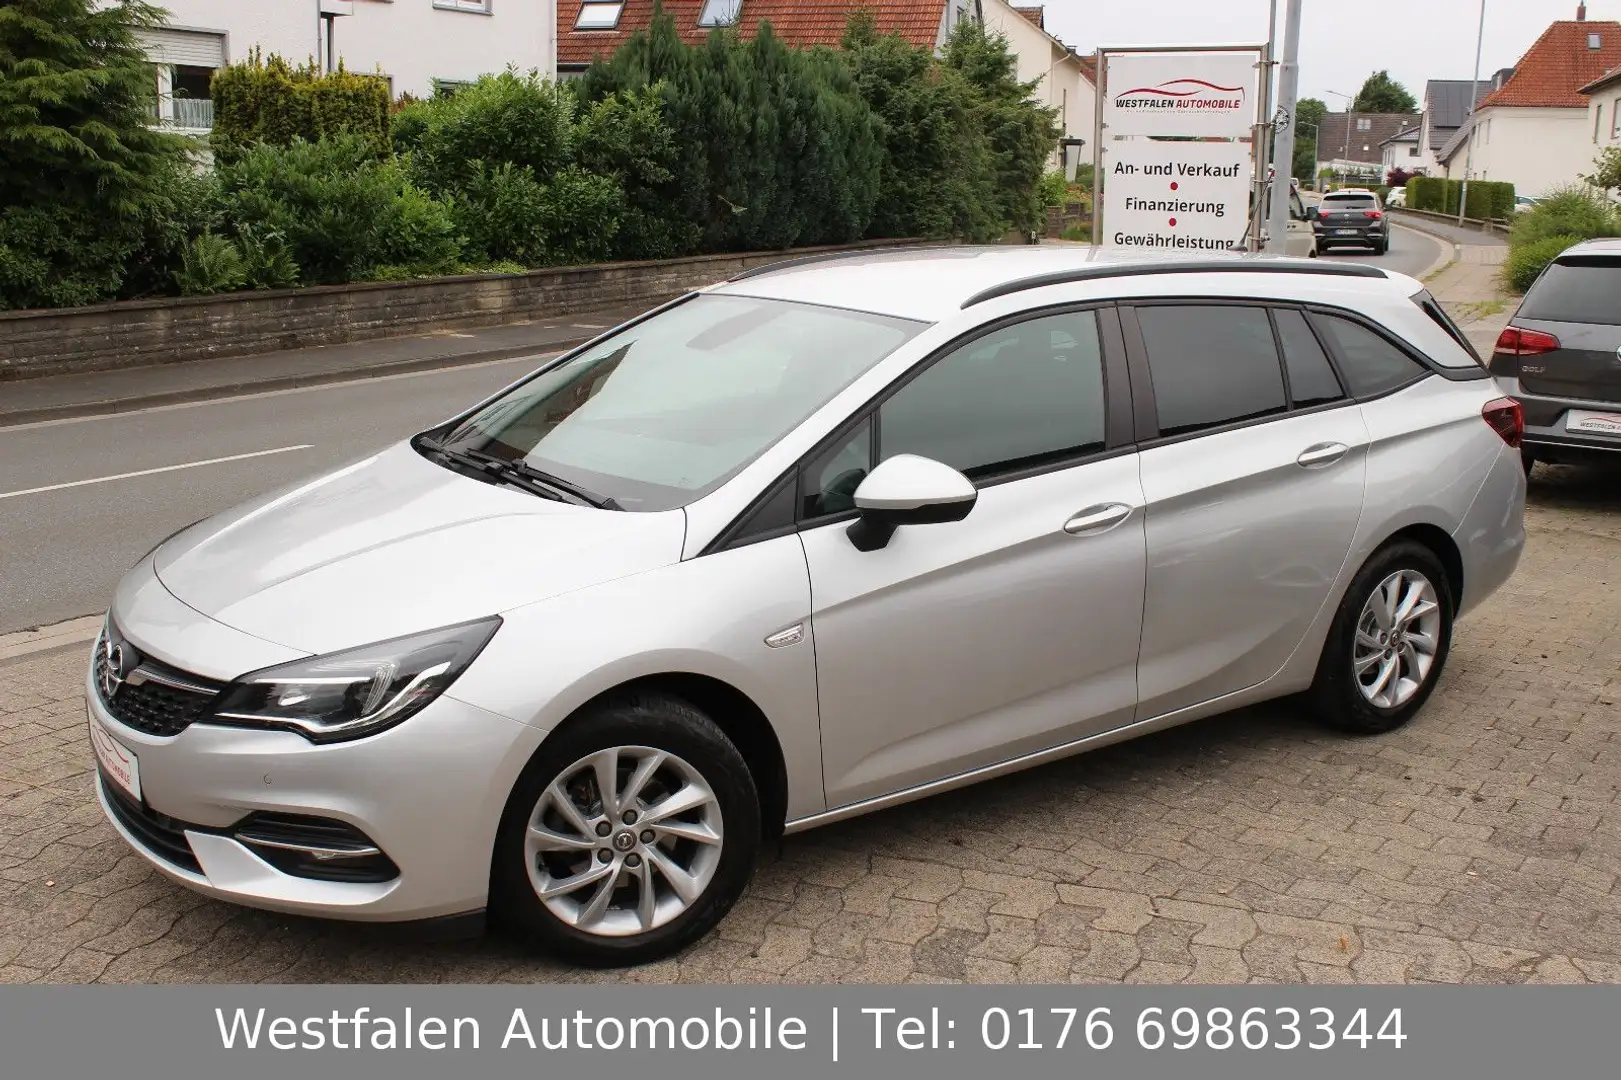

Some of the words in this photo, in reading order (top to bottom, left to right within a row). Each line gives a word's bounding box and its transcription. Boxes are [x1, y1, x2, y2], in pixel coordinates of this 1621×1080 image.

[1115, 99, 1174, 108] WESTFALEN
[1175, 99, 1241, 109] AUTOMOBILE
[1114, 161, 1139, 175] An-
[1144, 162, 1172, 176] und
[1177, 163, 1240, 177] Verkauf
[1125, 197, 1225, 217] Finanzierung
[1521, 365, 1546, 373] GOLF
